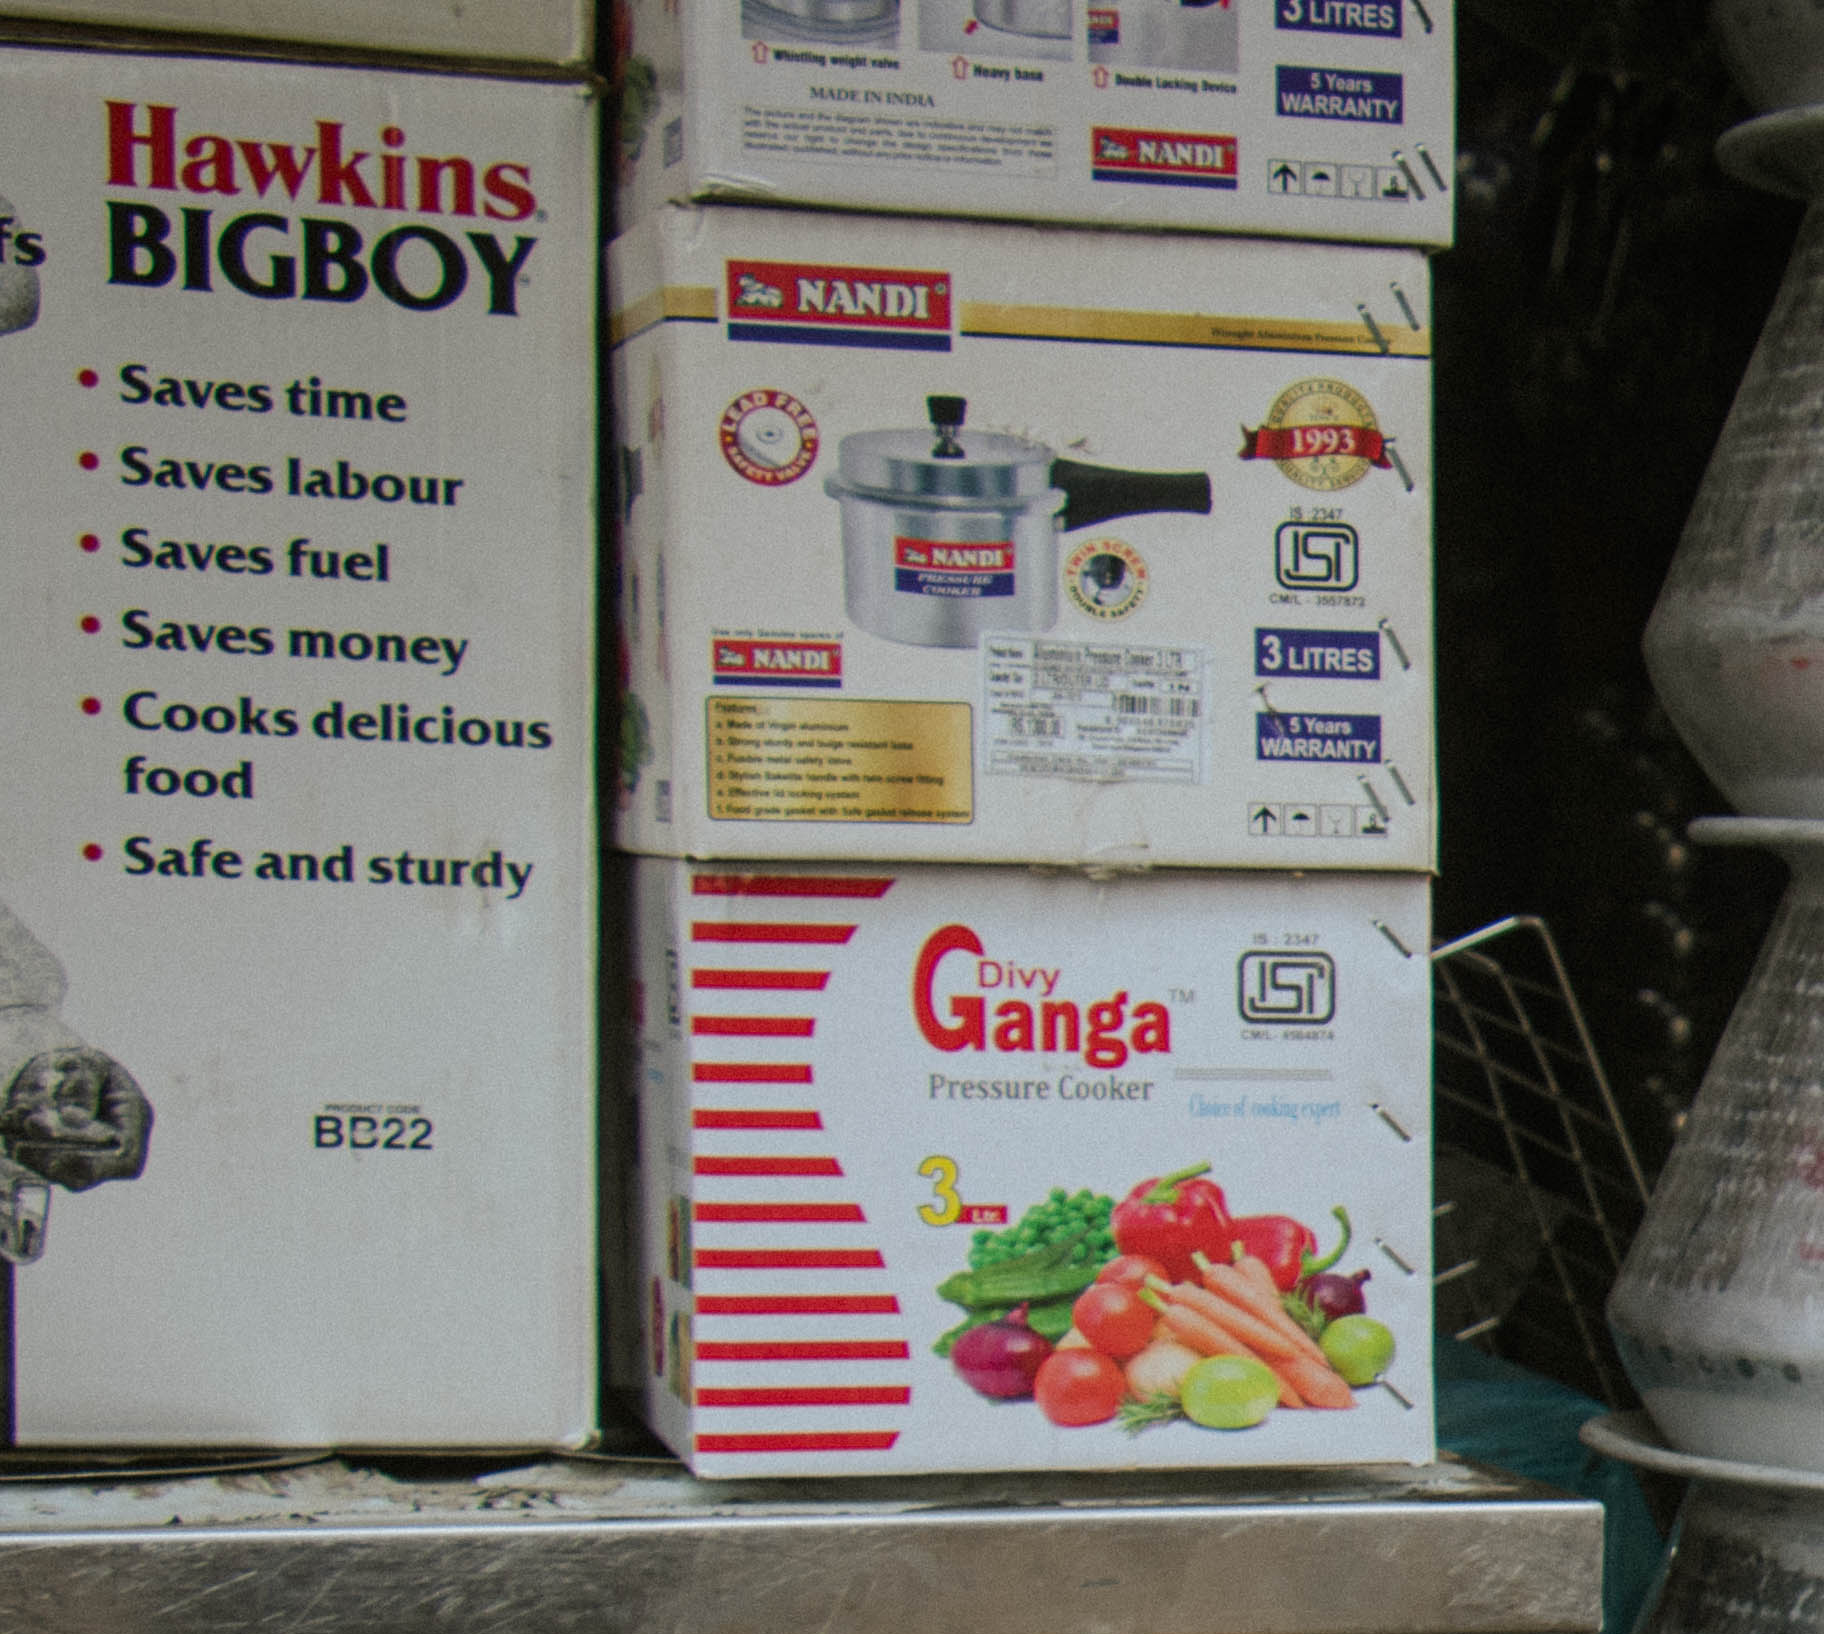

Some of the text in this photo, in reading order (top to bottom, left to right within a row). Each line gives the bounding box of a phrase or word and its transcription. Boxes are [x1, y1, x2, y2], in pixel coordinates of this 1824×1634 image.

[1309, 1, 1395, 29] LITRES
[973, 64, 1010, 81] Heavy
[1115, 73, 1237, 94] Double Locking Device
[1311, 72, 1373, 93] 5 Years
[810, 86, 935, 108] MADE IN INDIA
[1280, 92, 1399, 118] WARRANTY
[105, 100, 538, 222] Hawkins
[1136, 138, 1224, 169] NANDI
[107, 200, 537, 316] BIGBOY
[797, 278, 931, 320] NANDI
[120, 364, 407, 422] Saves time
[721, 390, 817, 440] LEAD FREE
[1292, 427, 1355, 453] 1993
[120, 446, 463, 506] Saves labour
[121, 528, 390, 582] Saves fuel
[931, 548, 1004, 567] NANDI
[121, 609, 469, 676] Saves money
[753, 647, 830, 671] NANDI
[1262, 634, 1374, 673] 3 LITRES
[123, 690, 553, 750] Cooks delicious
[1289, 716, 1352, 735] 5 Years
[1261, 736, 1376, 760] WARRANTY
[124, 755, 254, 800] food
[124, 836, 533, 900] Safe and sturdy
[912, 922, 1172, 1069] Ganga
[977, 959, 1062, 996] Divy
[929, 1072, 1155, 1101] Pressure Cooker
[1301, 1098, 1341, 1122] expert
[918, 1155, 962, 1228] 3
